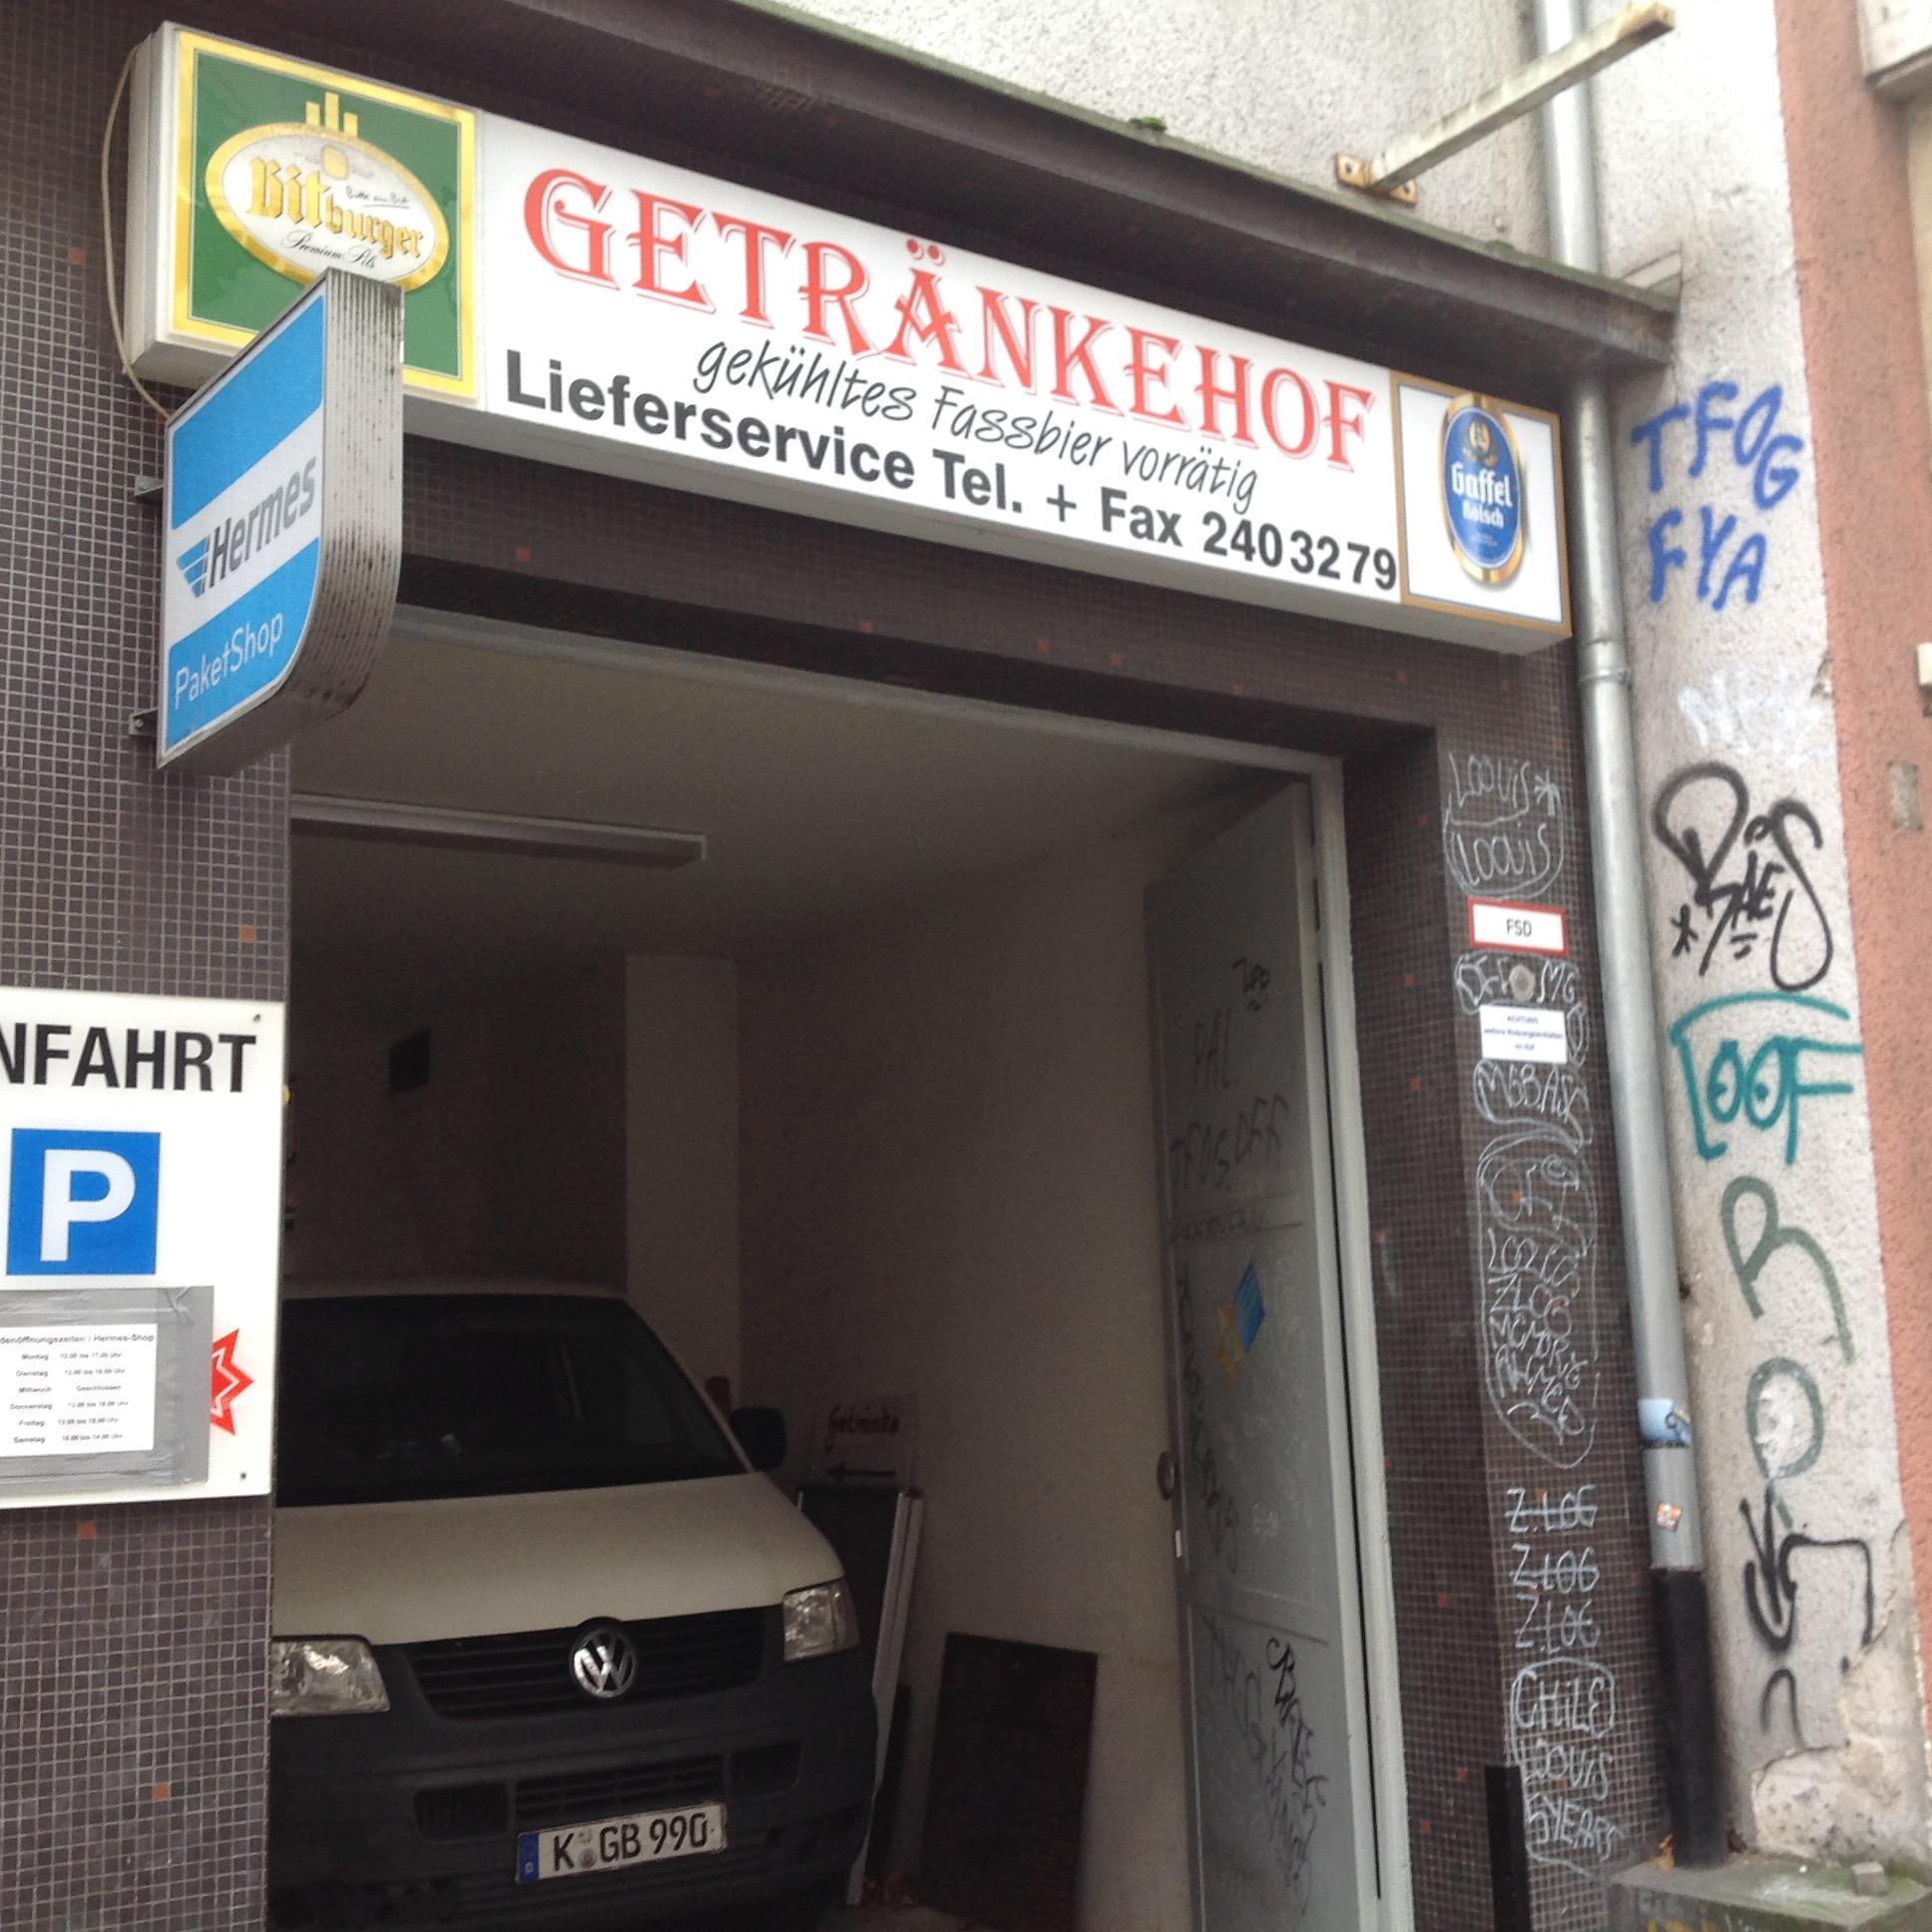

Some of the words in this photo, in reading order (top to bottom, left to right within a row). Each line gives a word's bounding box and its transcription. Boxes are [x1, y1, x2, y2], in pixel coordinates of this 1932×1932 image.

[247, 157, 424, 260] Bitburger
[281, 231, 342, 260] Premium
[346, 247, 376, 269] Pils
[523, 168, 1377, 474] GETRÄNKEHOF
[506, 348, 915, 490] Lieferservice
[932, 448, 1022, 514] Tel.
[1047, 484, 1077, 522] +
[1100, 486, 1183, 547] Fax
[693, 338, 917, 422] gekühltes
[931, 385, 1113, 467] Fassbier
[1123, 439, 1258, 514] vorrätig
[1631, 380, 1804, 511] TFOG
[209, 455, 316, 589] Hermes
[1451, 460, 1513, 508] Gaffel
[1647, 506, 1767, 612] FYA
[175, 612, 284, 711] PaketShop
[1506, 918, 1533, 938] FSD
[40, 1149, 137, 1261] P
[553, 1832, 575, 1872] K
[599, 1822, 642, 1863] GB
[649, 1812, 709, 1855] 990
